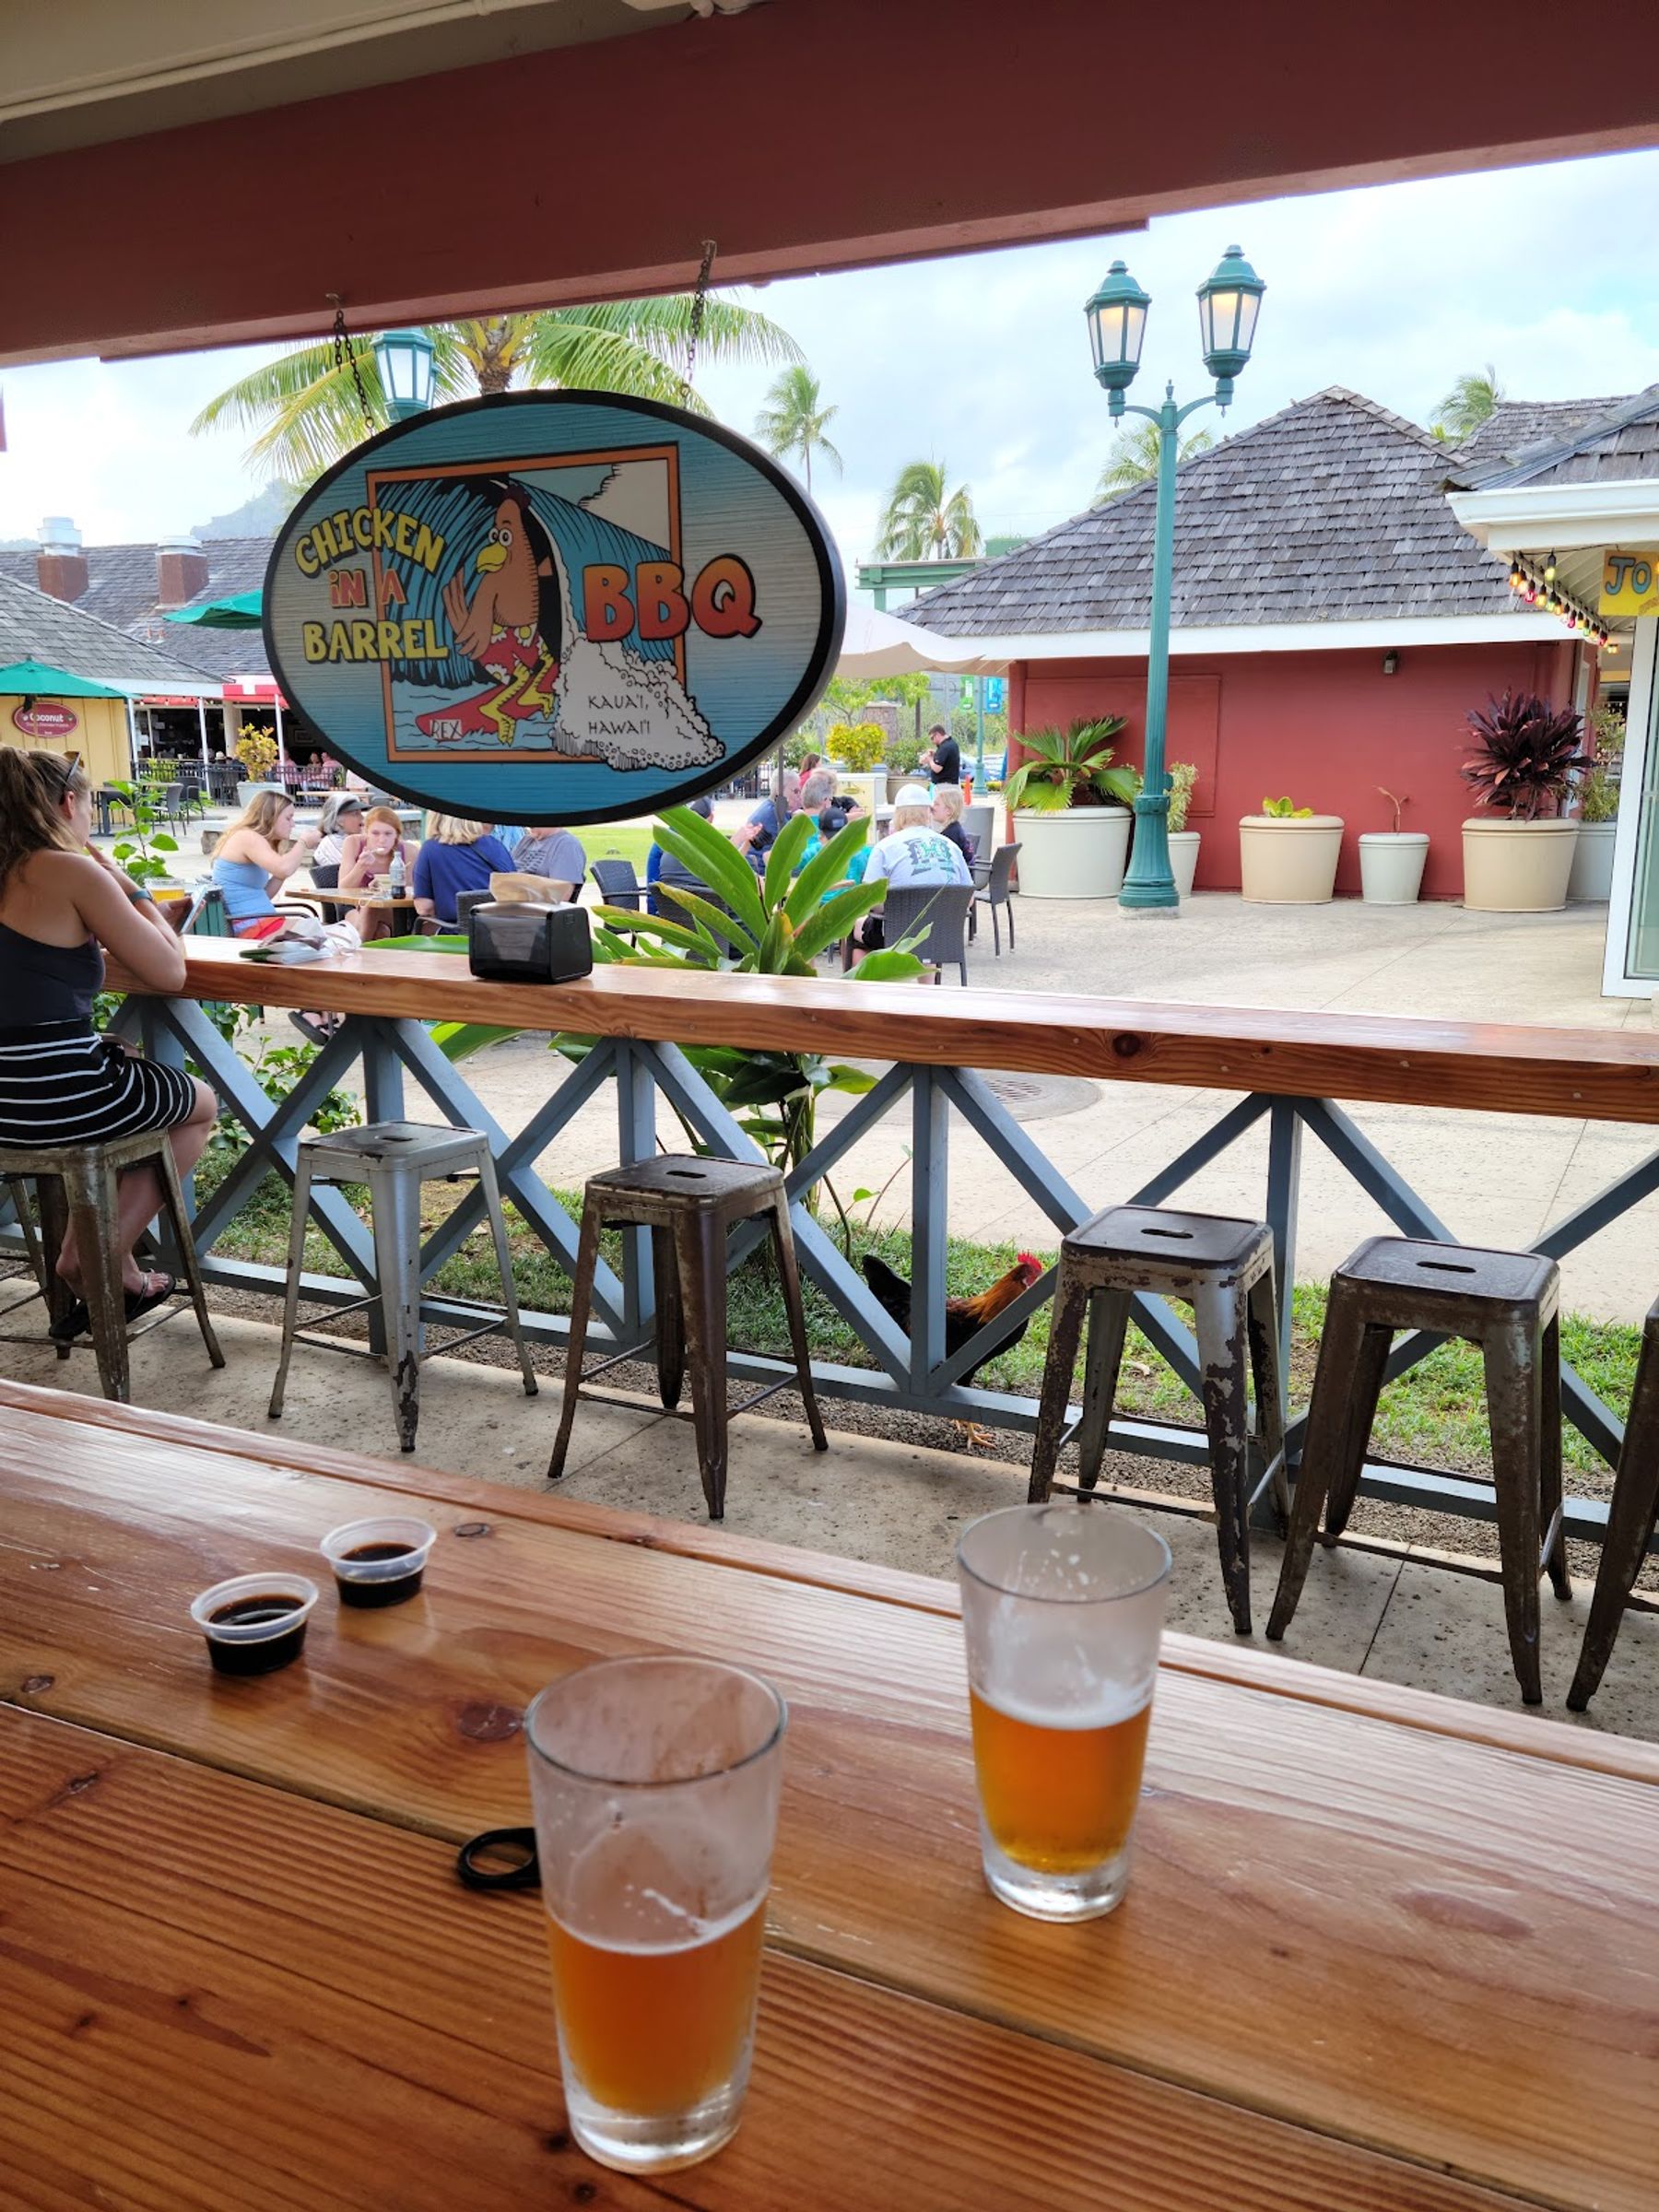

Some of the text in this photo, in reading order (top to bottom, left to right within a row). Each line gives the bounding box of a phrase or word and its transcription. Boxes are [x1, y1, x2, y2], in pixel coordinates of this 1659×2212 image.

[295, 506, 447, 578] CHICKEN
[382, 568, 408, 605] A
[582, 554, 763, 642] BBQ
[302, 619, 450, 664] BARREL
[431, 719, 464, 740] REX
